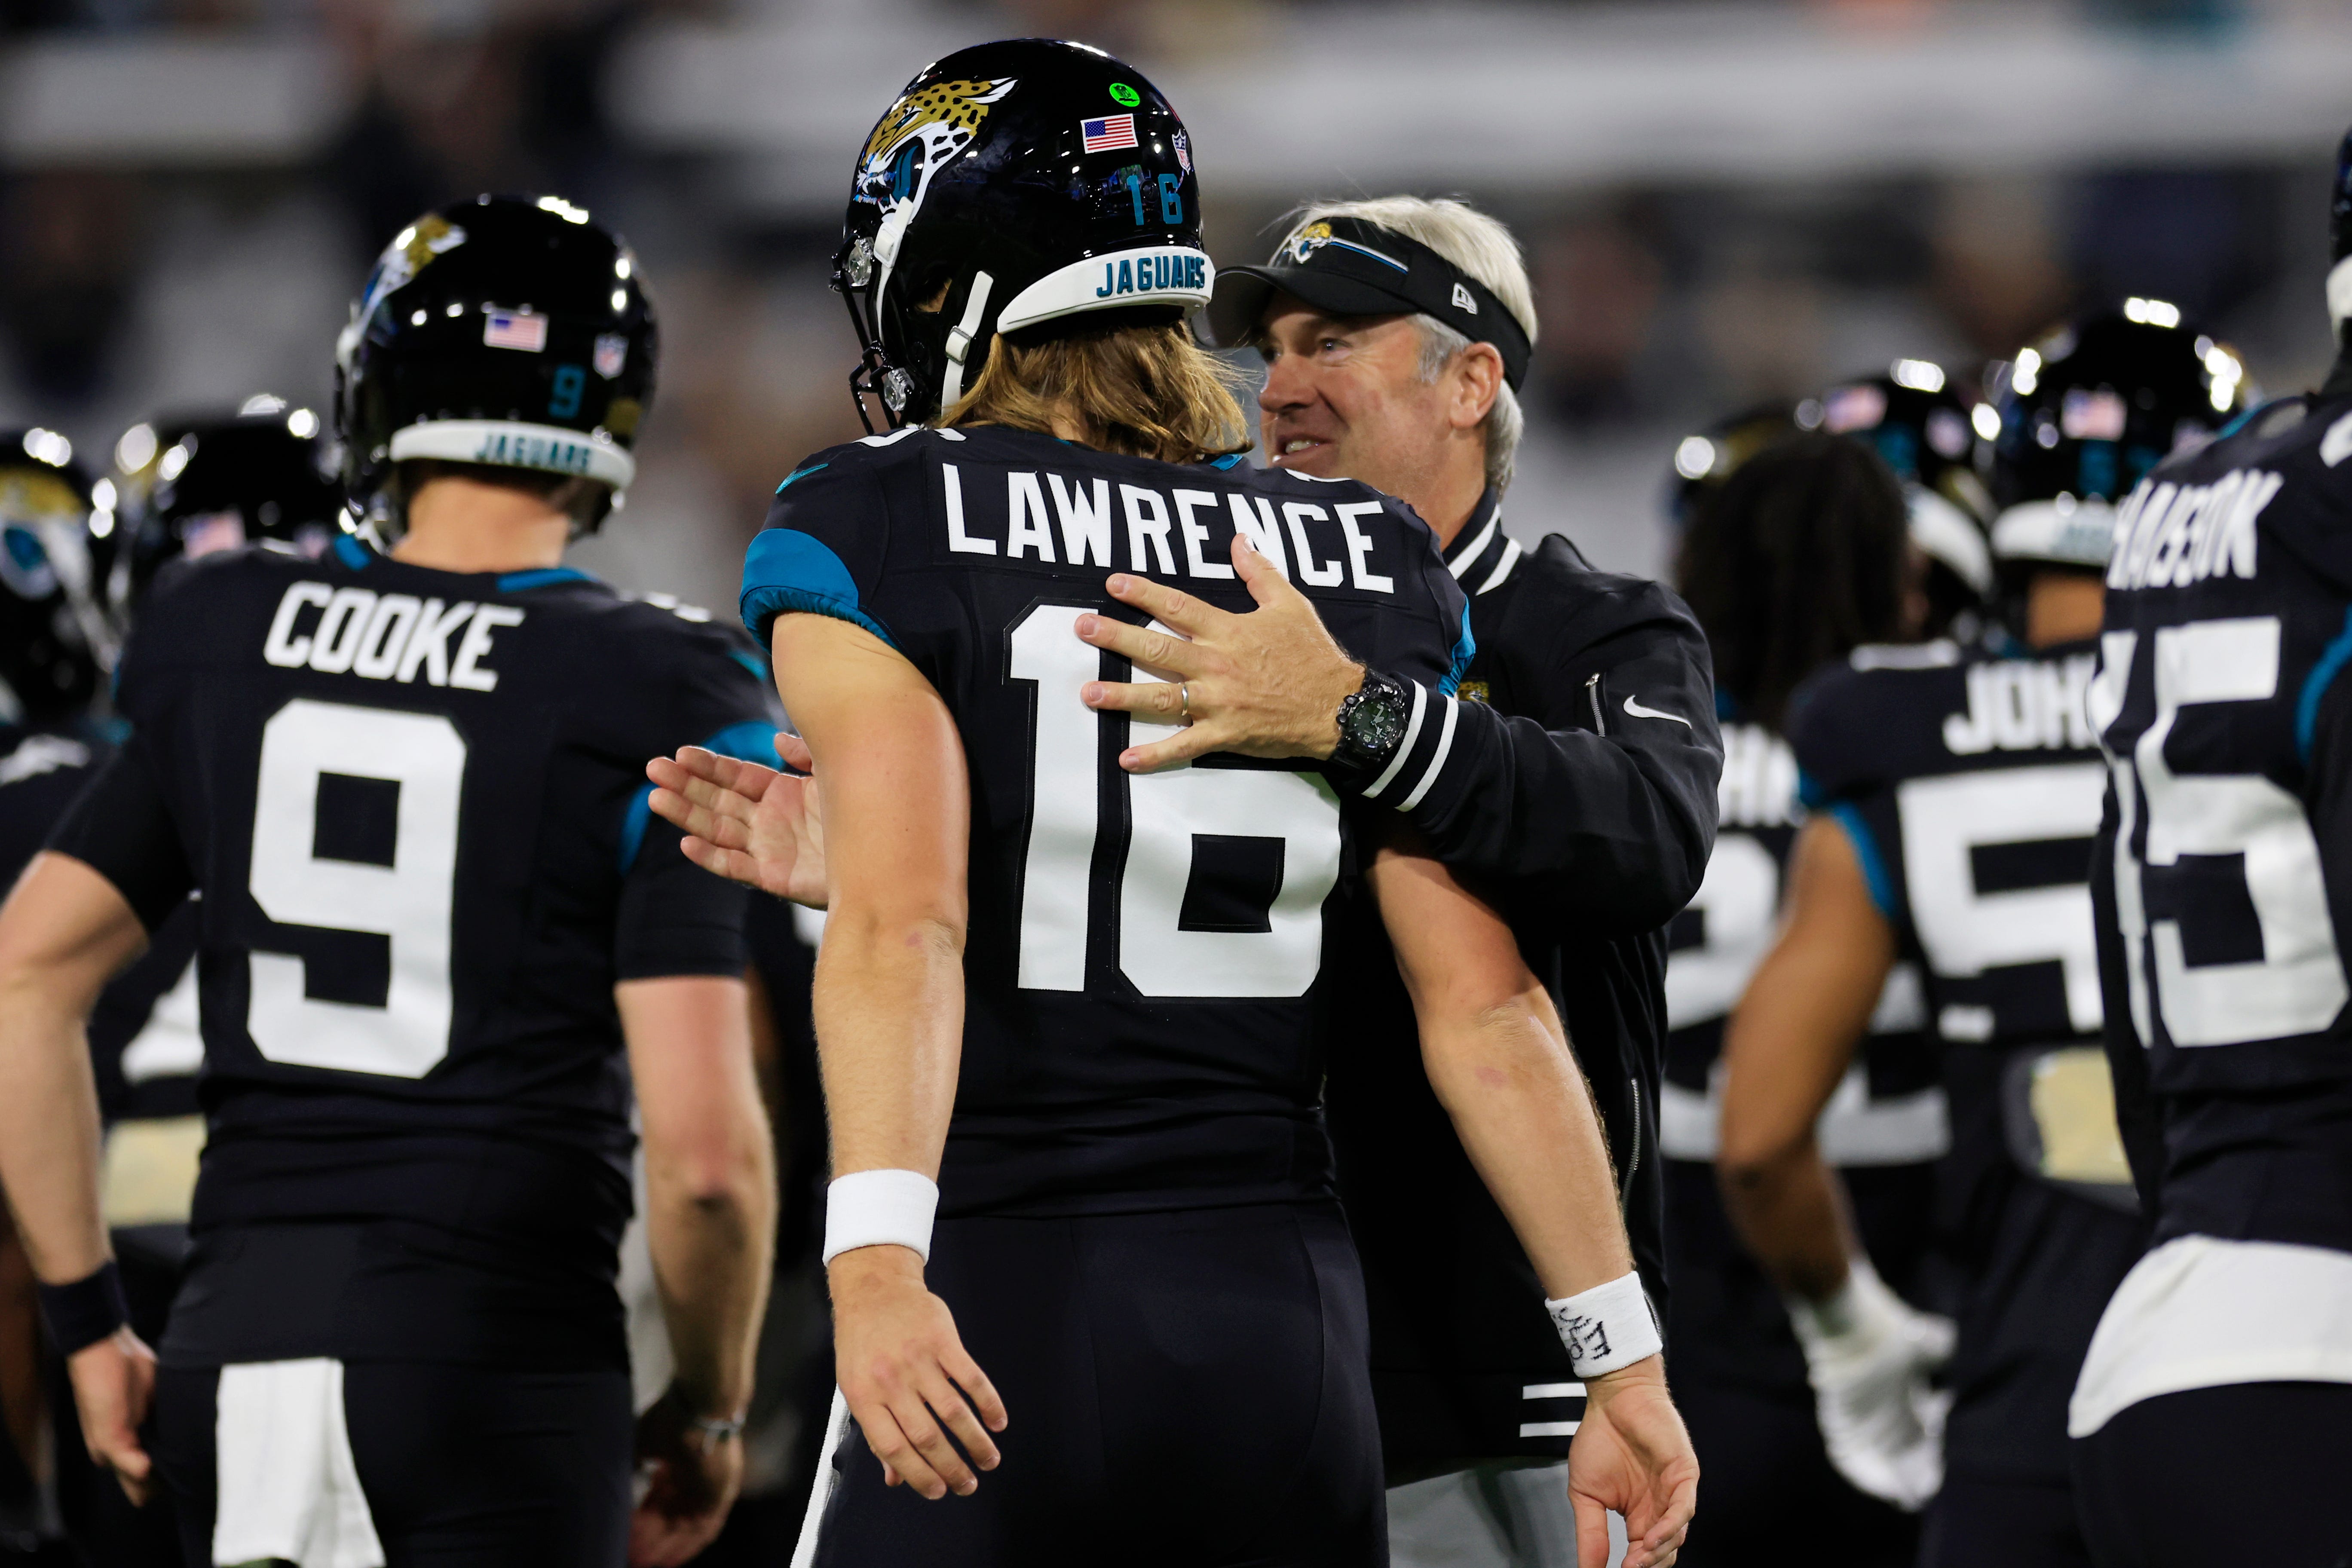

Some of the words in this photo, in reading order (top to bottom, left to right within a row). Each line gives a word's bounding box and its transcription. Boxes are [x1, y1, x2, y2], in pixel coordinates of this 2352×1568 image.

[1127, 173, 1182, 225] 16
[1096, 255, 1205, 297] JAGUARS
[548, 364, 586, 420] 9
[942, 463, 1394, 594] LAWRENCE
[263, 580, 525, 692] COOKE
[1010, 604, 1340, 997] 16
[247, 698, 467, 1079] 9
